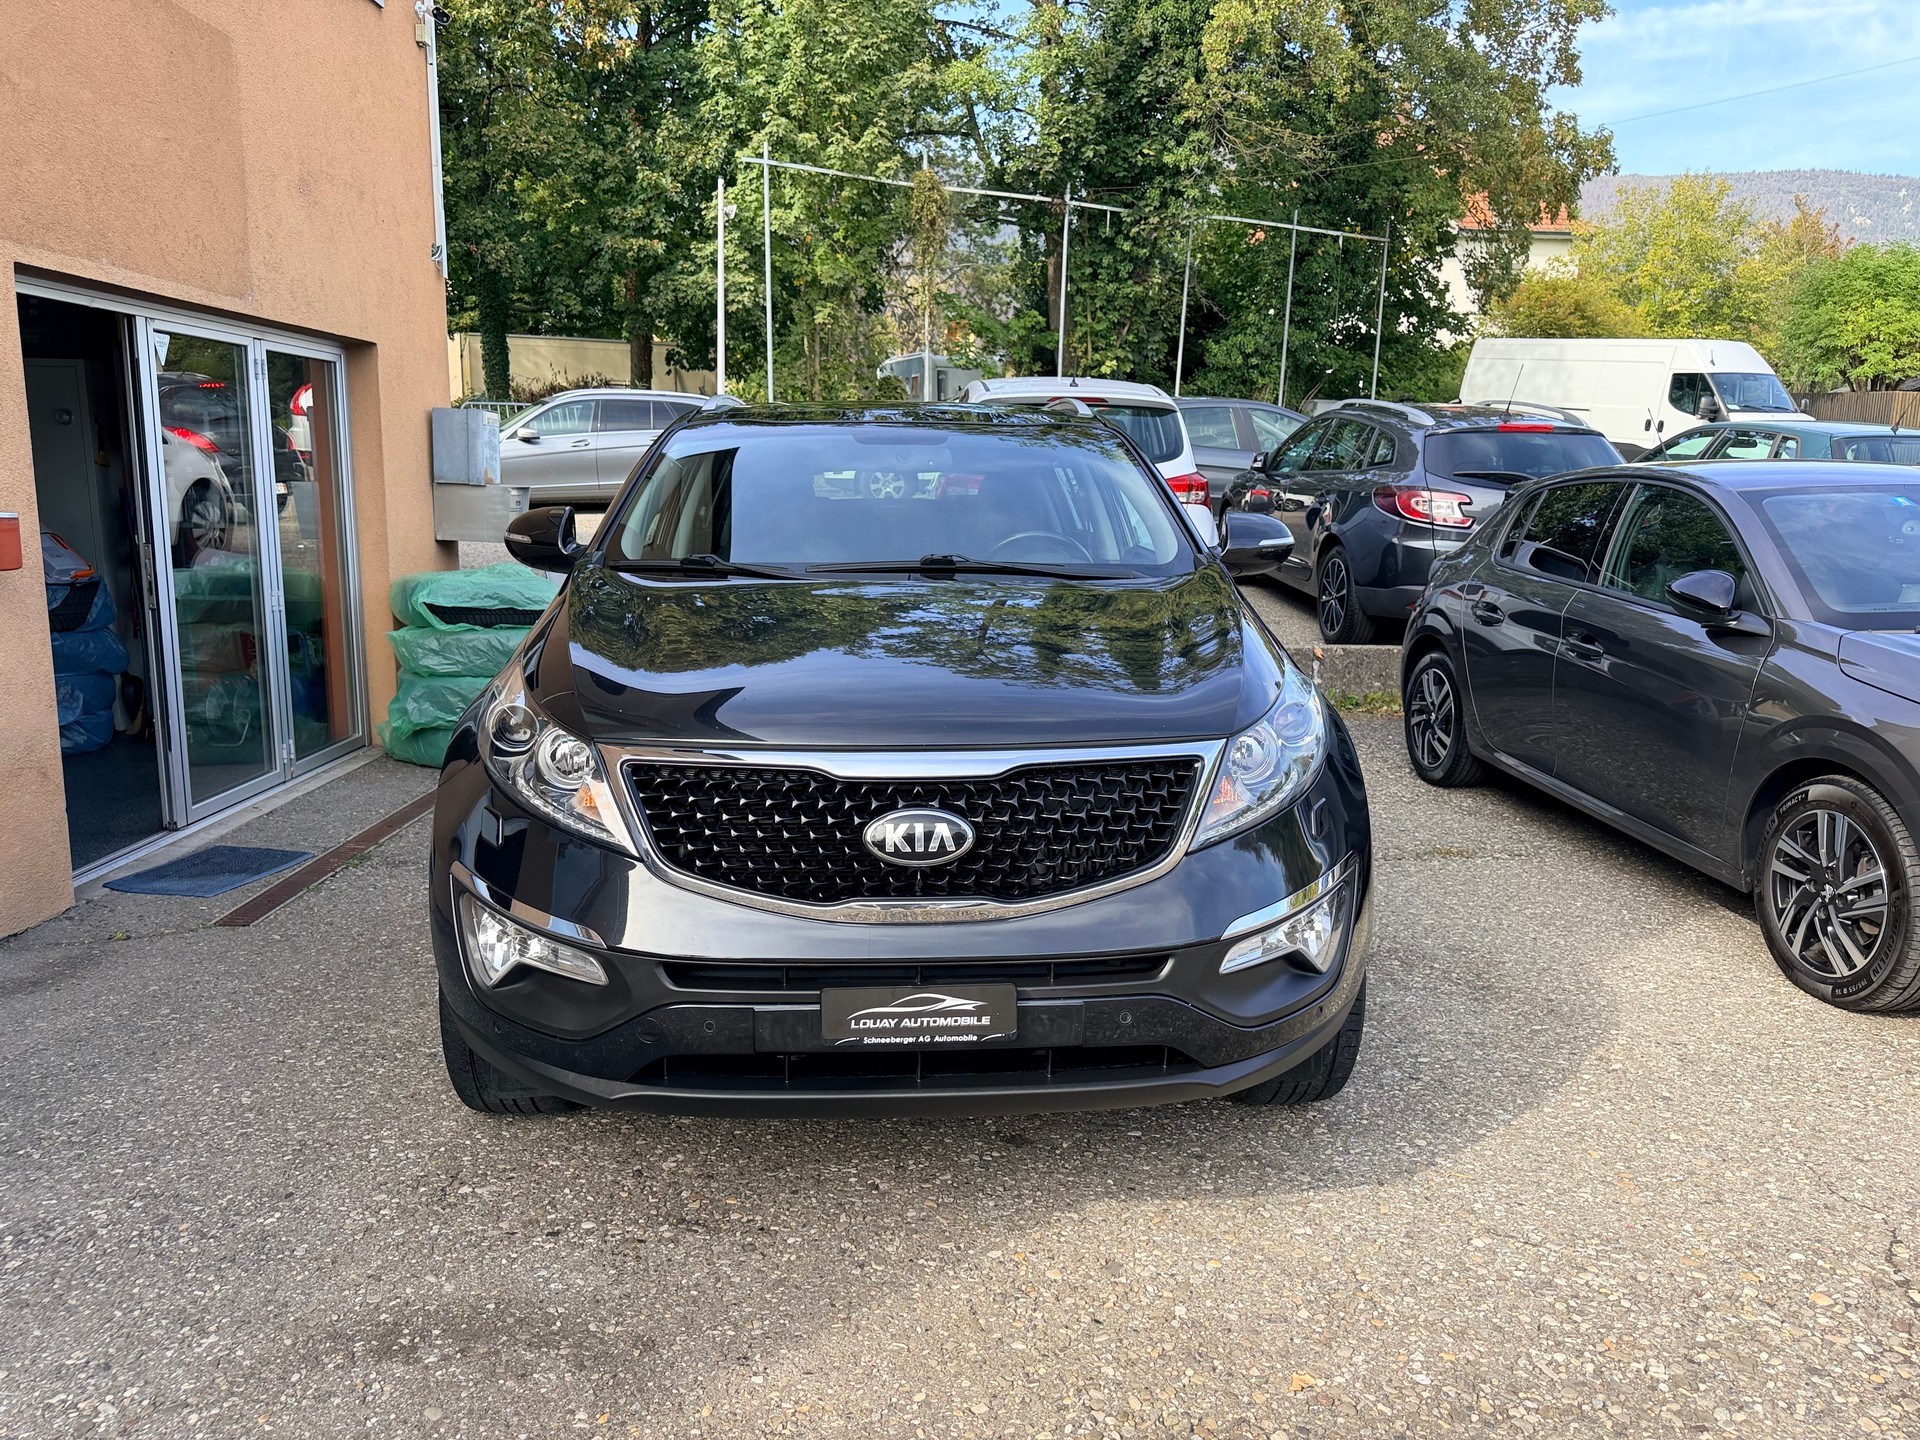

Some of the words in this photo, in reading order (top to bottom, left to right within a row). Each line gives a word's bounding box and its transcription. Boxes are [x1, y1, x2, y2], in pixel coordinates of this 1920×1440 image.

[1779, 794, 1802, 815] PRIMACY
[883, 822, 957, 853] KIA
[1872, 915, 1900, 978] MICHELIN
[1848, 978, 1868, 993] 195/55
[850, 1018, 897, 1029] LOUAY
[899, 1015, 991, 1028] AUTOMOBILE
[863, 1035, 916, 1045] Schneeberger
[917, 1034, 931, 1043] AG
[933, 1034, 978, 1043] Automobile
